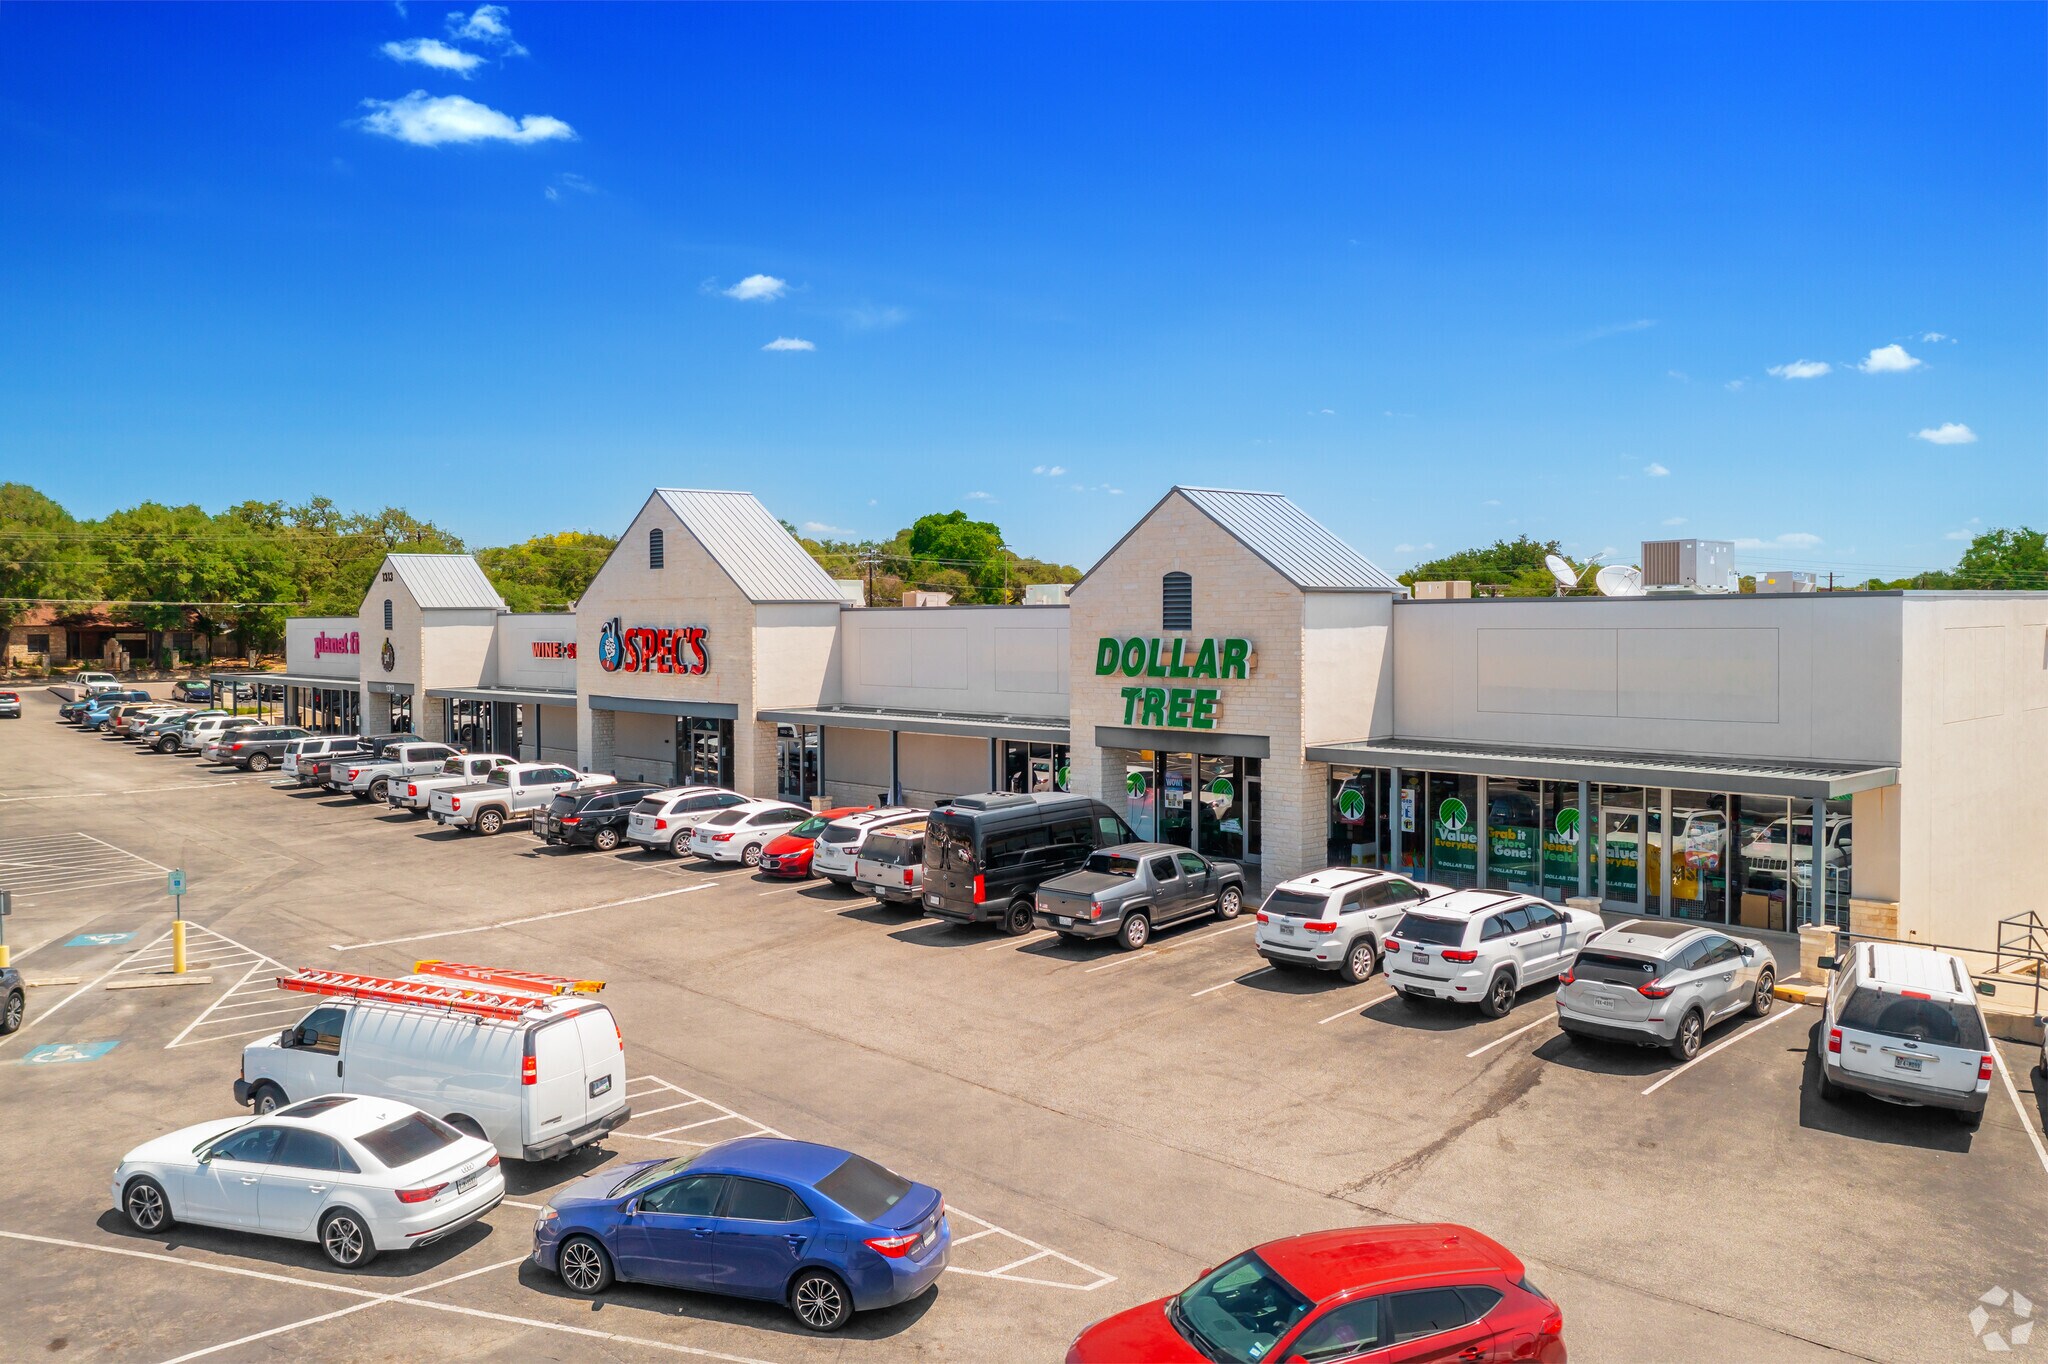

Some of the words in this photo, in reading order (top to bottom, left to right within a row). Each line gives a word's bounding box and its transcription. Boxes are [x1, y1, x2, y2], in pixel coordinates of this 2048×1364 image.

[314, 631, 348, 658] planet
[531, 641, 562, 659] WINE
[624, 627, 708, 676] SPEC'S
[1095, 637, 1252, 680] DOLLAR
[1121, 687, 1222, 729] TREE
[1438, 827, 1478, 843] Value
[1491, 837, 1526, 849] Before
[1517, 830, 1527, 840] it
[1493, 845, 1532, 859] Gone!
[1442, 861, 1462, 869] DOLLAR
